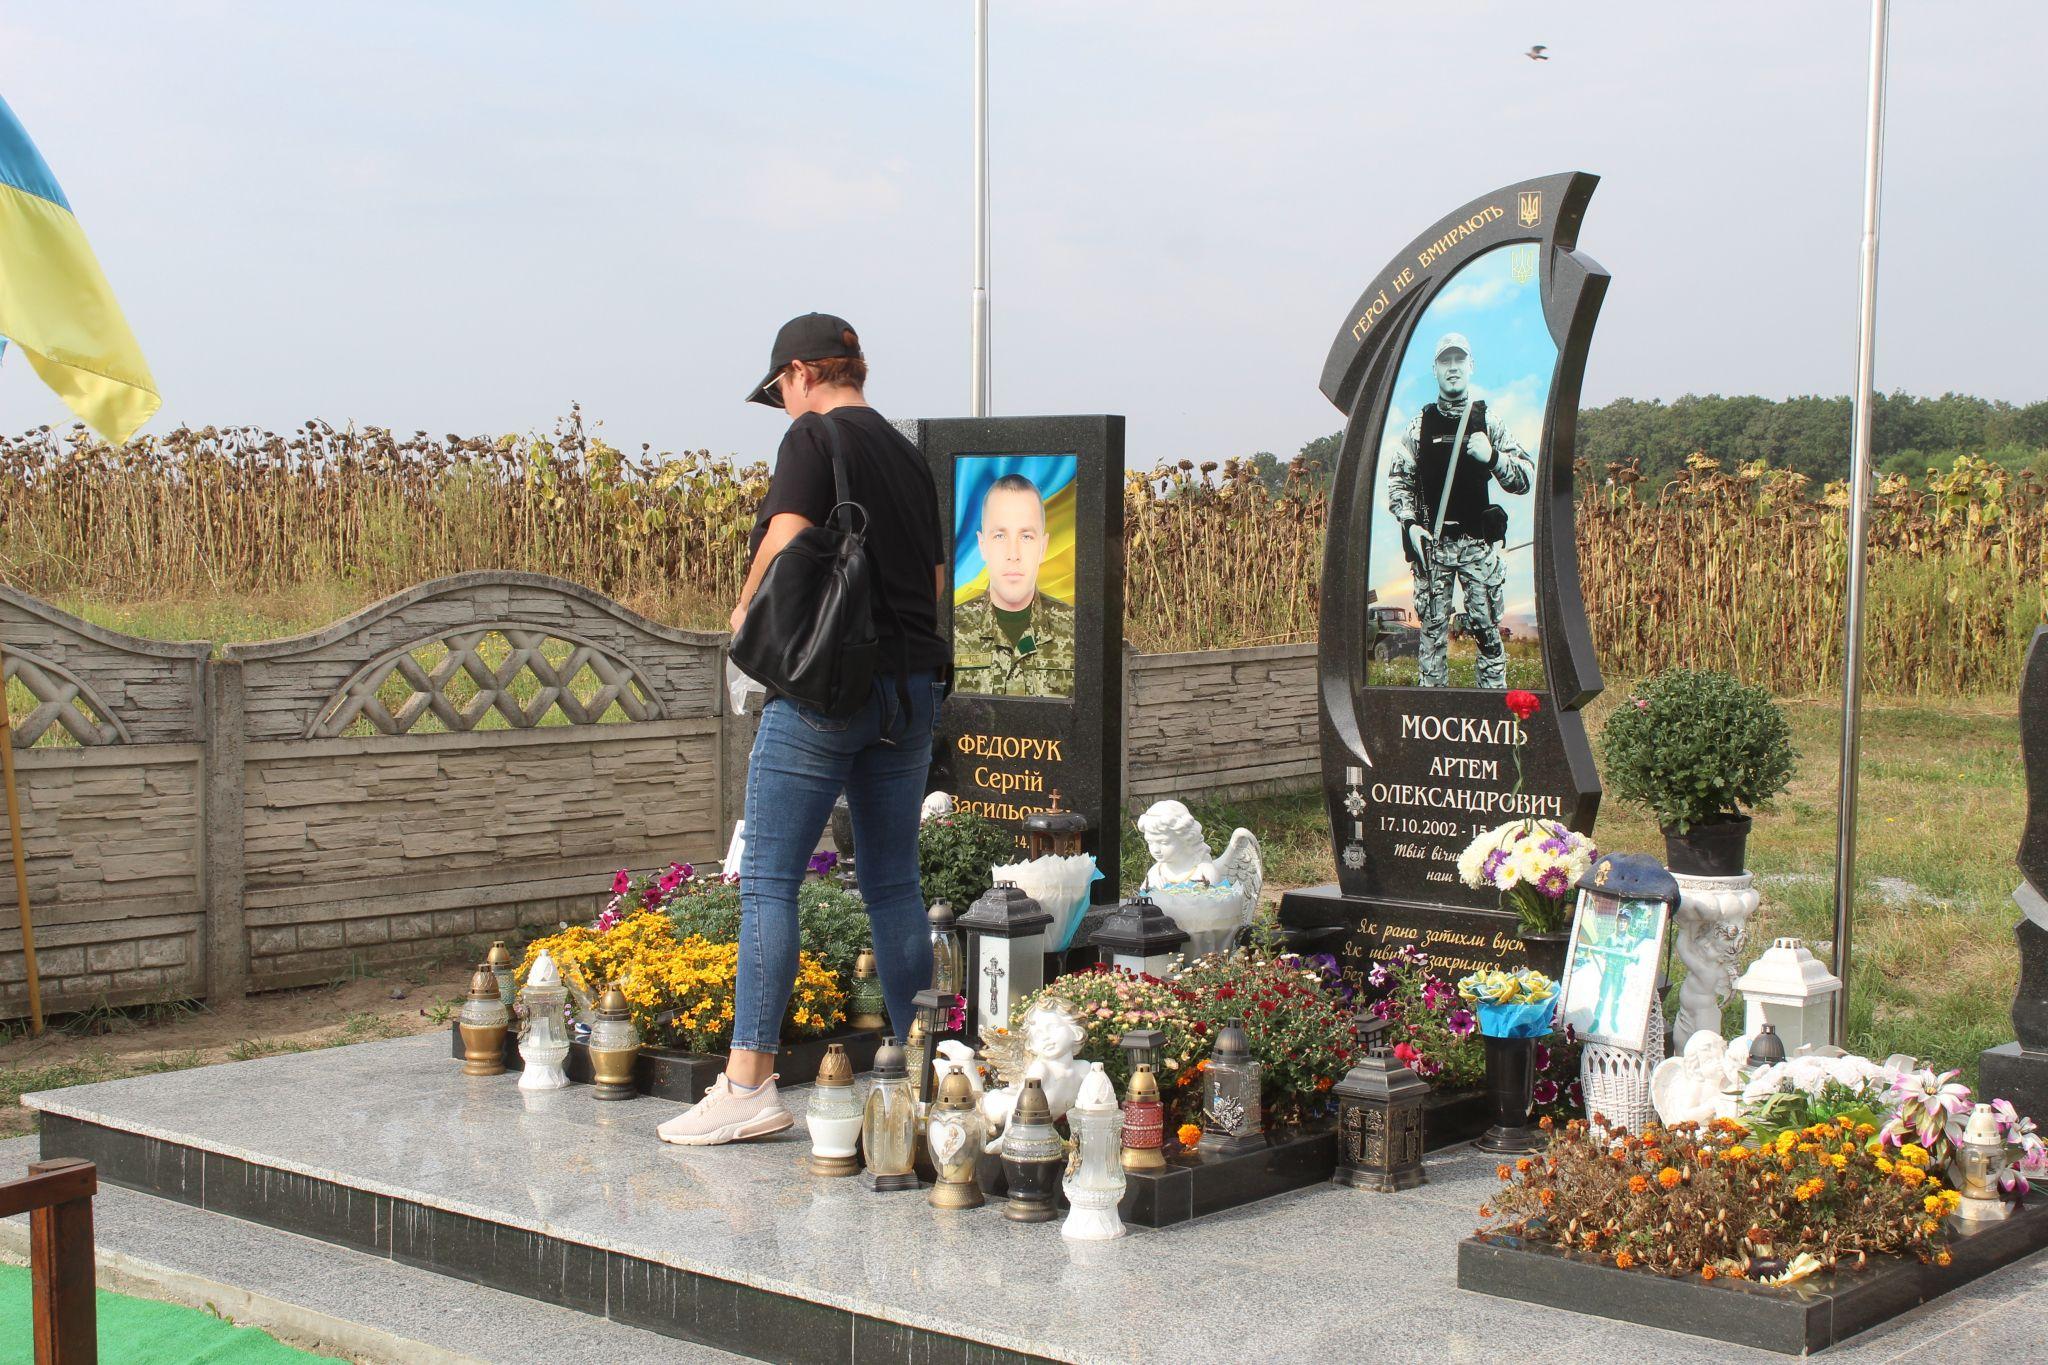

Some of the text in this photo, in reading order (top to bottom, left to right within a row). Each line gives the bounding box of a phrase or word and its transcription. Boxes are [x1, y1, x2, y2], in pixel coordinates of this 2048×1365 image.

[1352, 204, 1504, 342] ГЕРОЇ НЕ ВМИРАЮТЬ
[1401, 714, 1528, 746] МОСКАЛЬ
[957, 734, 1063, 762] ФЕДОРУК
[974, 767, 1044, 795] Сергій
[1429, 756, 1498, 781] АРТЕМ
[949, 795, 1071, 821] Васильо
[1371, 783, 1562, 817] ОЛЕКСАНДРОВИЧ
[1379, 816, 1457, 838] 17.10.2002
[1426, 871, 1453, 883] наш
[1342, 941, 1363, 958] Як
[1357, 918, 1526, 957] Як рано затихли вуст
[1342, 965, 1364, 986] Без
